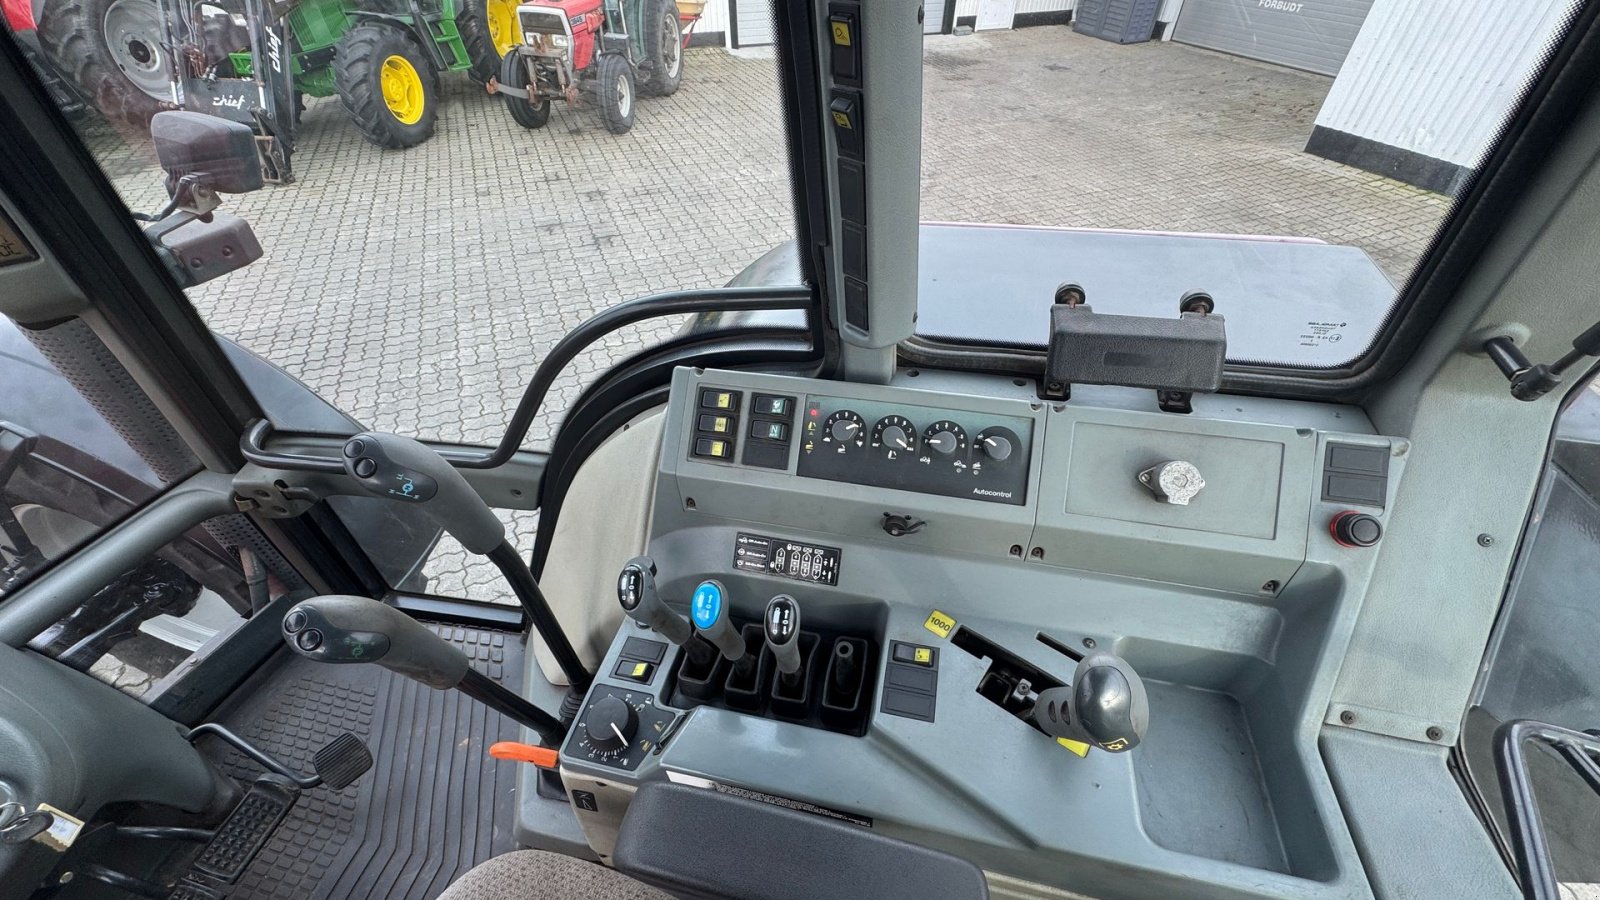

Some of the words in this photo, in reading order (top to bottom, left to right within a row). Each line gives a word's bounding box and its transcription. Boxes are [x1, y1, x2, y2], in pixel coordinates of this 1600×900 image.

[1258, 0, 1304, 13] FORBUDT
[973, 487, 1012, 498] Autocontrol
[930, 616, 951, 632] 1000
